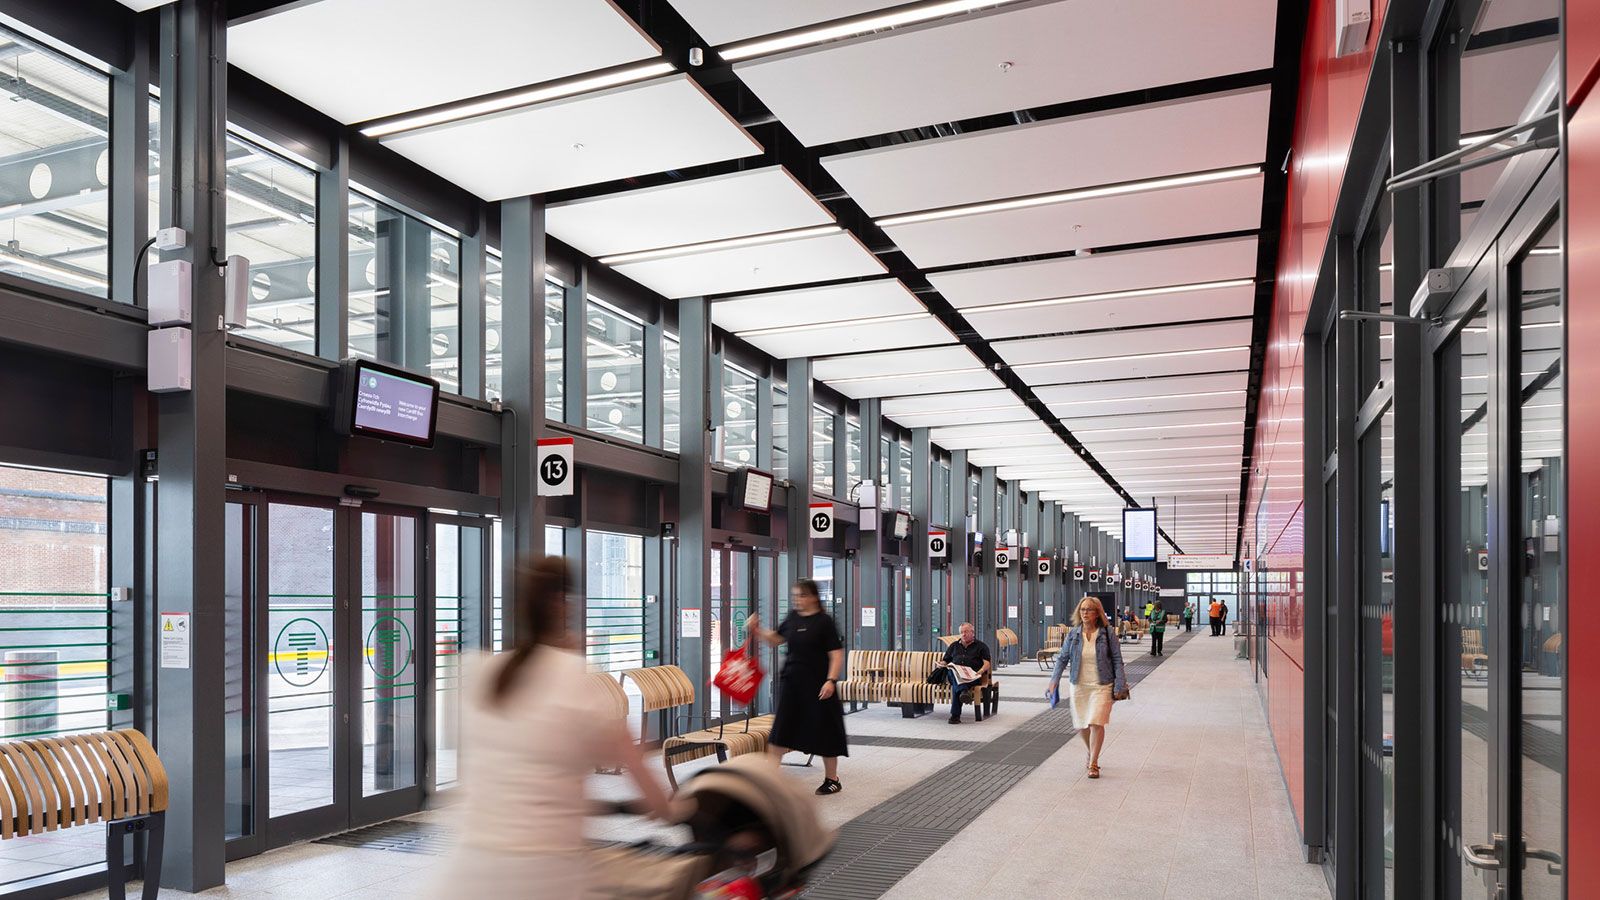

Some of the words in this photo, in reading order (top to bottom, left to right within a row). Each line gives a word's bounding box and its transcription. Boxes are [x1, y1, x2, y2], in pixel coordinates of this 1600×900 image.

[545, 460, 563, 479] 13
[815, 517, 827, 529] 12
[933, 541, 941, 550] 11
[998, 554, 1006, 563] 10
